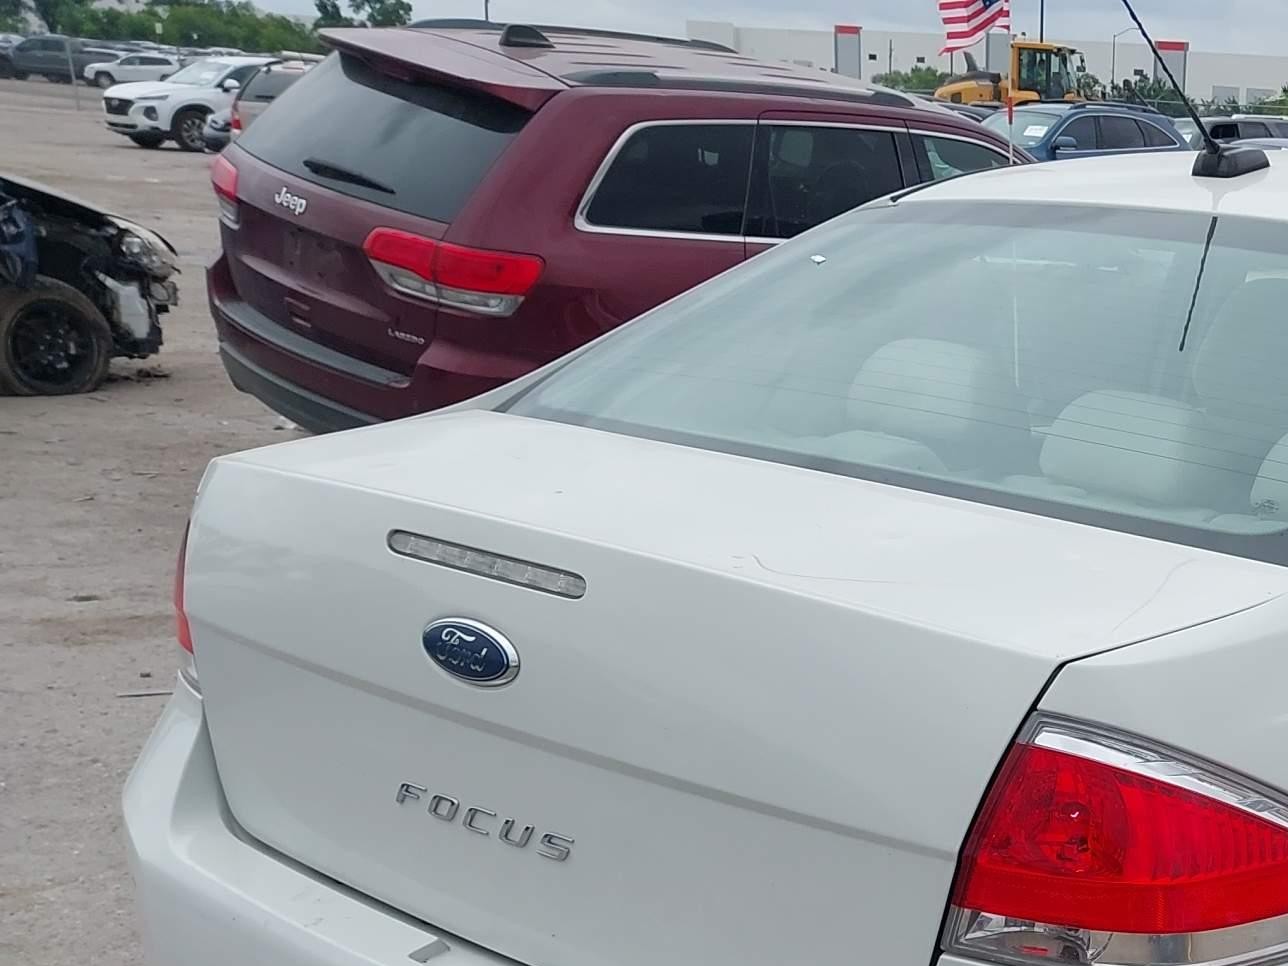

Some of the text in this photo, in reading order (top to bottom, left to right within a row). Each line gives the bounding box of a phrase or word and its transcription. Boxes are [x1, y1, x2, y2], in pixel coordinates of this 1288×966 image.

[274, 186, 307, 216] Jeep
[437, 627, 488, 673] Ford
[395, 781, 575, 862] FOCUS
